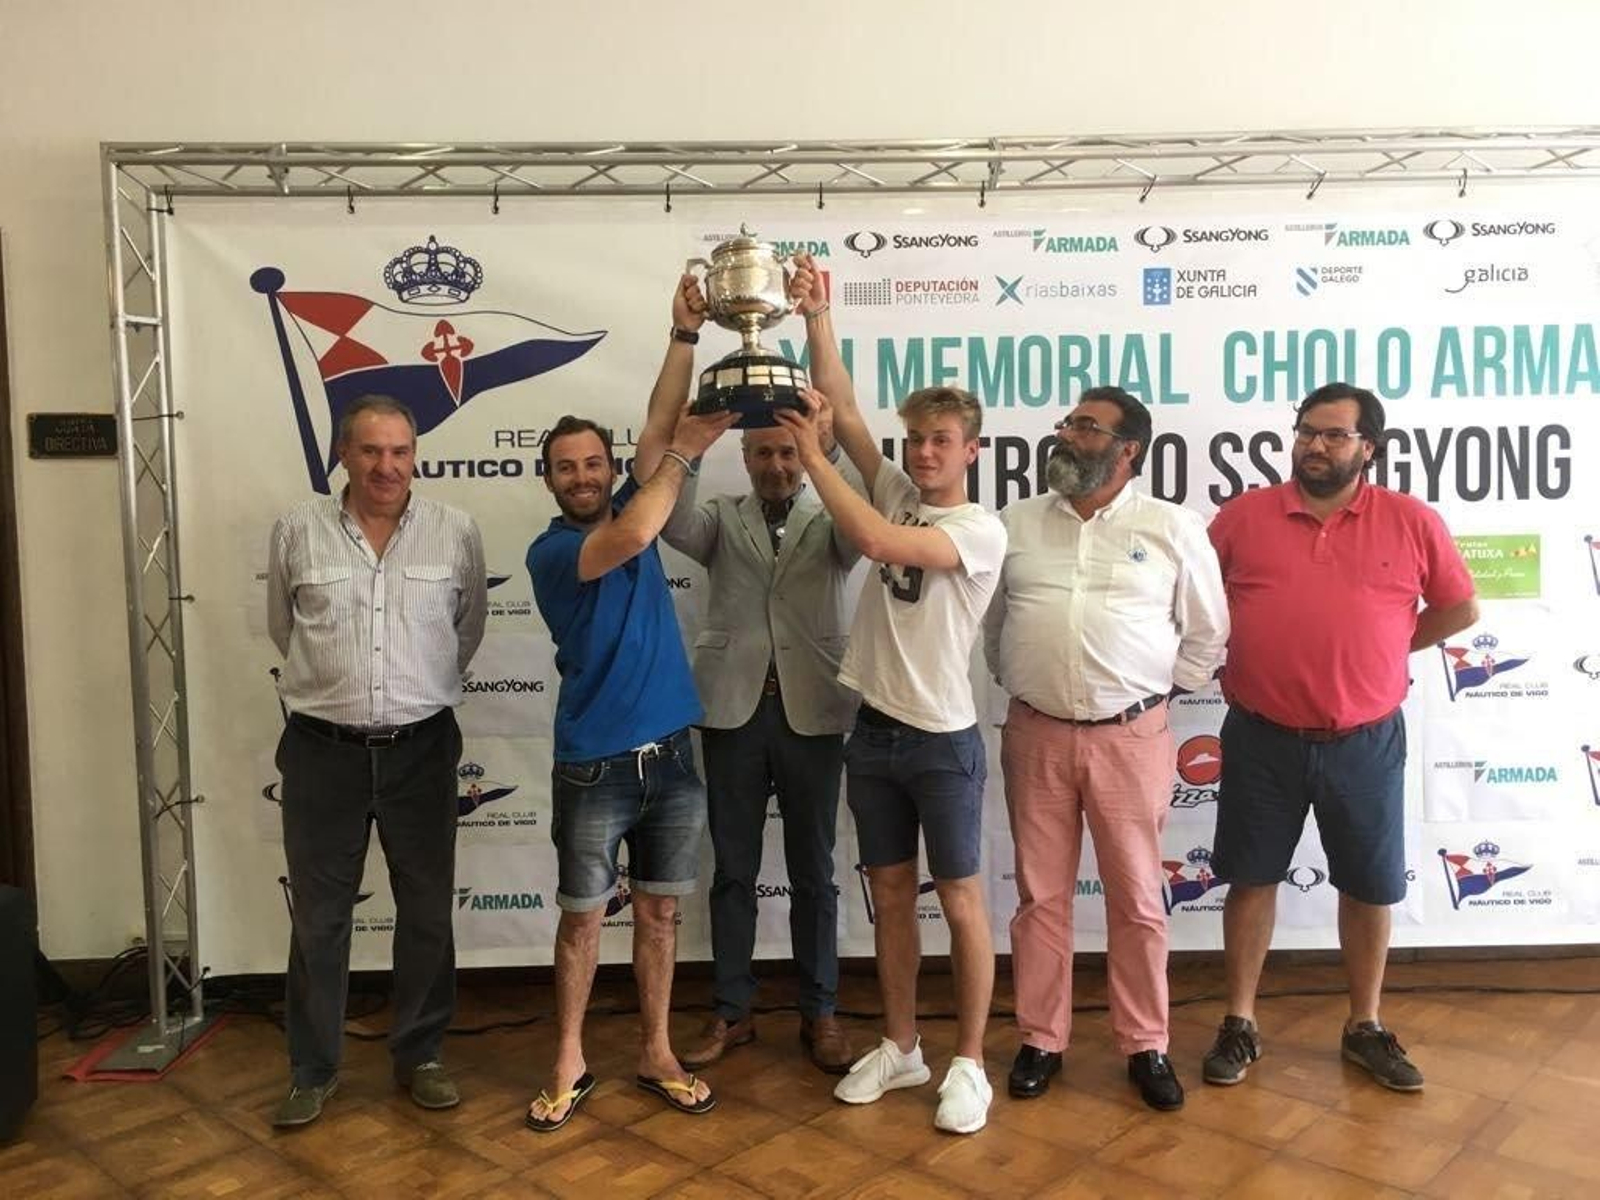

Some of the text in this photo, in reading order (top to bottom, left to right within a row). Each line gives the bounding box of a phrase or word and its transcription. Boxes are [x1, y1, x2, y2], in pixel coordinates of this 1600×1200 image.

[1045, 236, 1119, 253] ARMADA
[1336, 229, 1411, 247] ARMADA
[1177, 269, 1226, 283] XUNTA
[1321, 266, 1363, 275] DEPORTE
[1321, 275, 1360, 283] GALEGO
[1444, 263, 1529, 294] galicia
[895, 275, 979, 293] DEPUTACIÓN
[1176, 284, 1257, 299] DE GALICIA
[895, 292, 979, 305] PONTEVEDRA
[877, 332, 1190, 409] MEMORIAL
[1223, 326, 1412, 404] CHOLO
[1486, 766, 1558, 784] ARMADA
[471, 893, 544, 911] ARMADA
